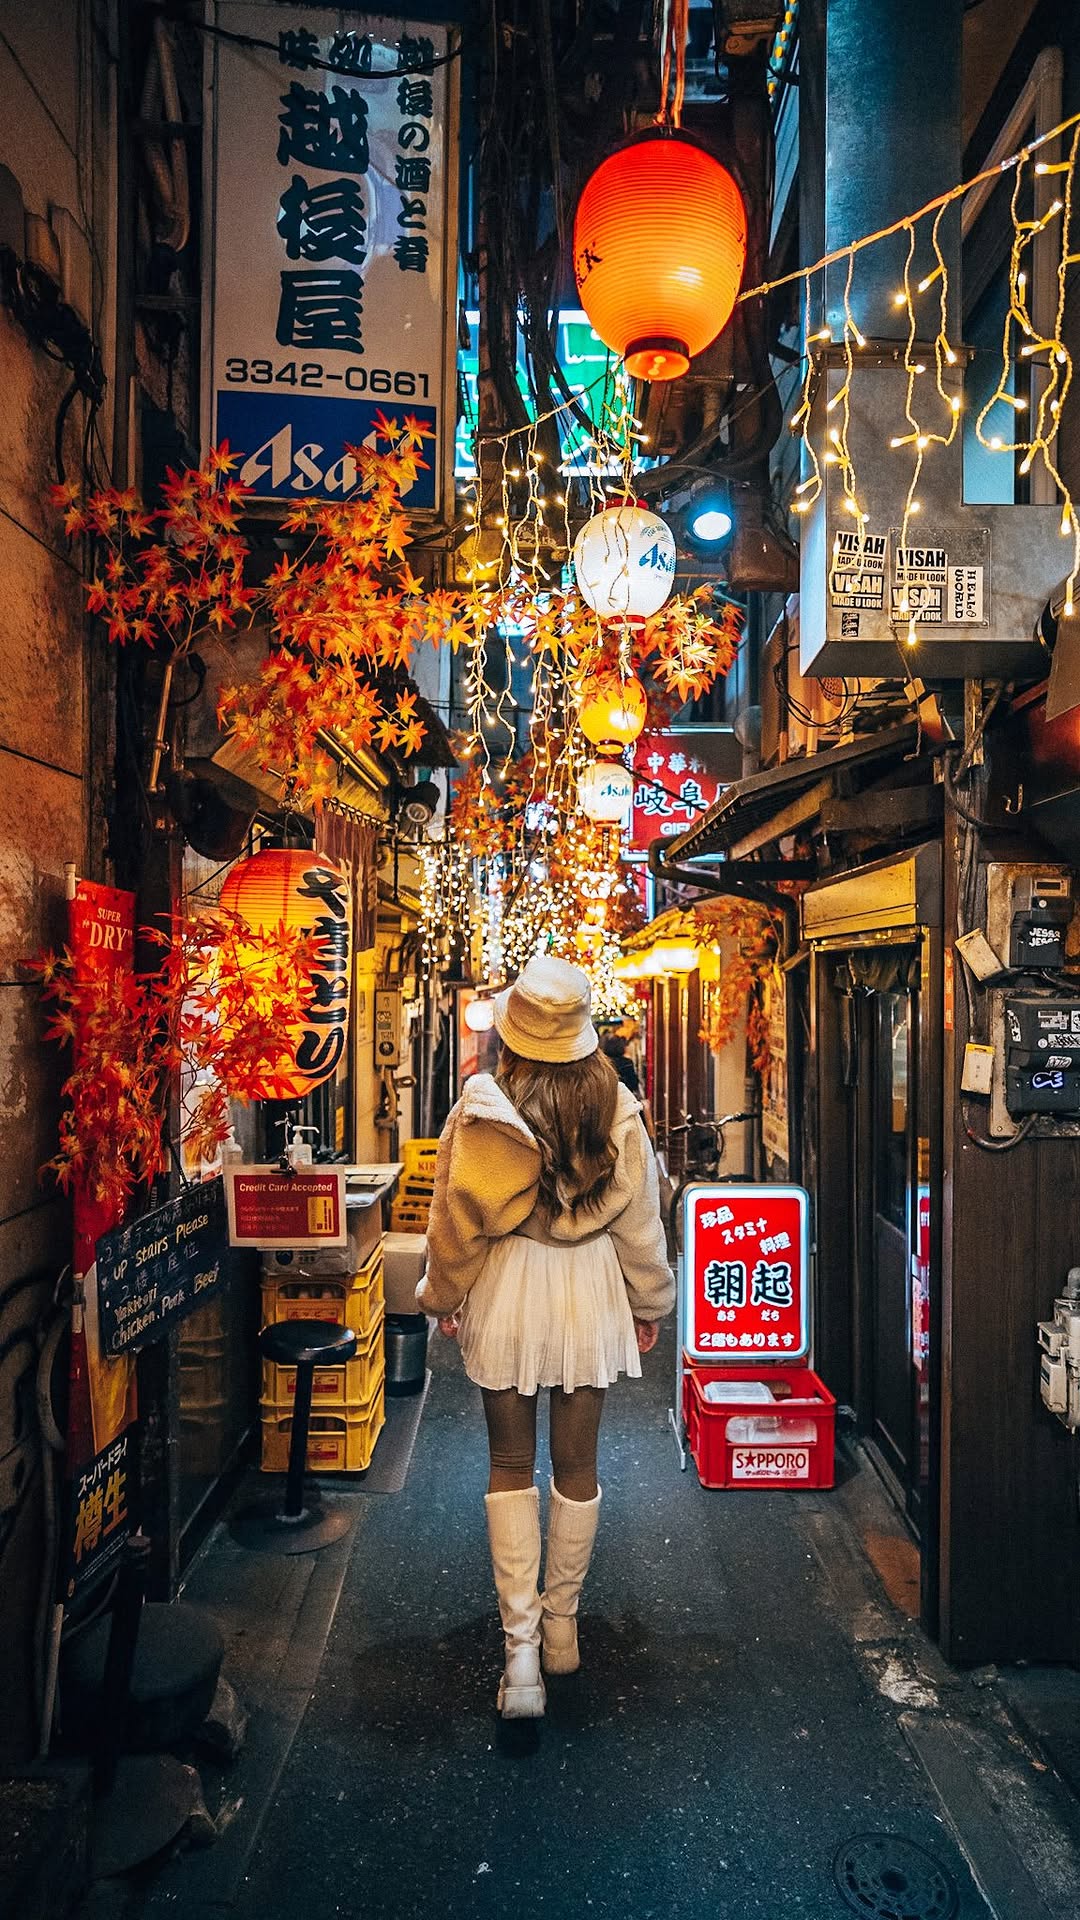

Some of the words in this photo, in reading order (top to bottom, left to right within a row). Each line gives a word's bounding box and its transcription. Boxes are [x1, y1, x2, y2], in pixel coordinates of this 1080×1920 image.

[276, 80, 370, 355] 越後屋
[225, 358, 429, 398] 3342-0661
[838, 533, 885, 554] VISAH
[898, 549, 946, 567] VISAH
[897, 572, 918, 581] MDE
[926, 573, 946, 582] LOOK
[862, 598, 882, 608] LOOK
[892, 588, 940, 606] VSAH
[97, 907, 121, 922] SUPER
[239, 1183, 266, 1192] Credit
[268, 1183, 289, 1192] Card
[291, 1182, 333, 1193] Accepted
[699, 1205, 735, 1229] 珍品
[721, 1217, 768, 1245] スタミナ
[758, 1231, 792, 1256] 料理
[705, 1261, 792, 1307] 朝起
[761, 1309, 779, 1322] だち
[78, 1437, 128, 1498] スーパードライ
[73, 1468, 128, 1564] 樽生
